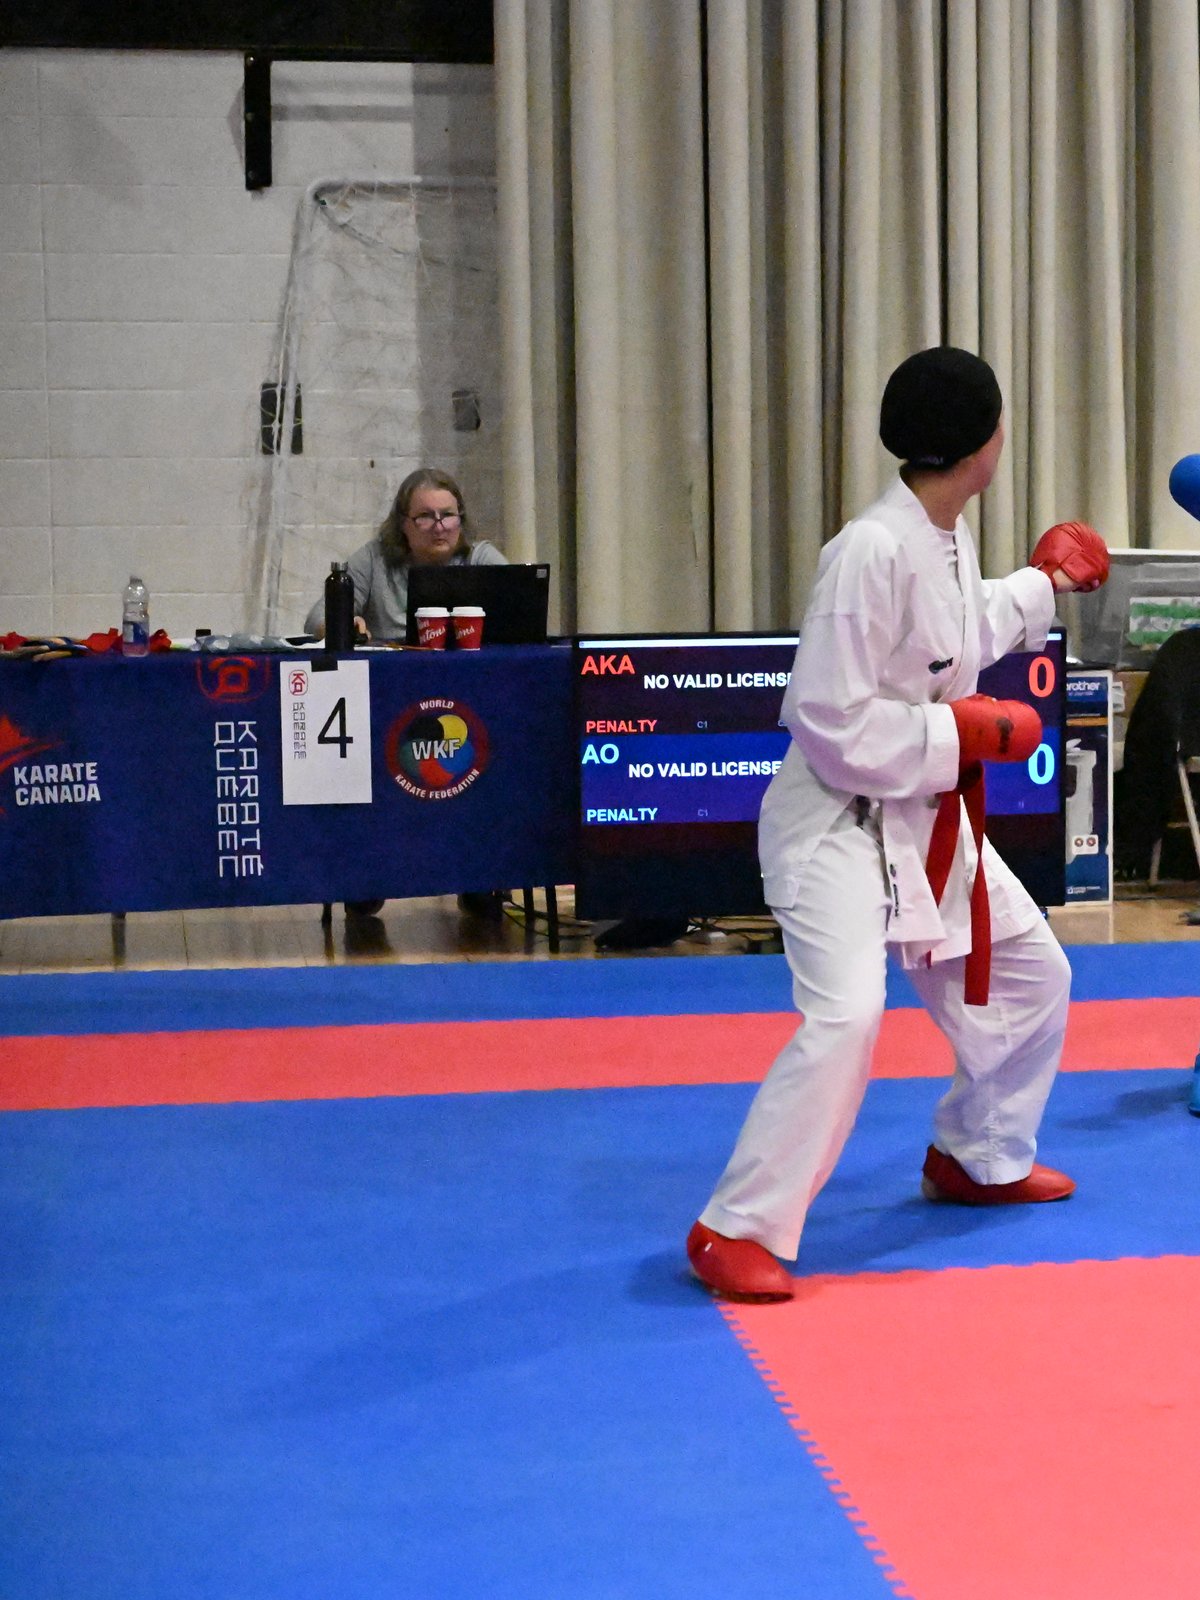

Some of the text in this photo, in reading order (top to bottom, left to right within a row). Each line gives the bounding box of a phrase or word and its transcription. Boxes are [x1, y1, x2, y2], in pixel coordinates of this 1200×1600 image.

[581, 654, 635, 675] AKA
[643, 674, 669, 689] NO
[673, 673, 723, 689] VALID
[1028, 656, 1056, 698] 0
[420, 699, 455, 711] WORLD
[317, 696, 354, 759] 4
[586, 719, 657, 733] PENALTY
[696, 721, 708, 729] C1
[411, 738, 461, 760] WKF
[581, 743, 620, 765] AO
[13, 762, 98, 786] KARATE
[628, 763, 654, 778] NO
[657, 762, 707, 778] VALID
[1028, 743, 1055, 785] 0
[15, 783, 101, 806] CANADA
[395, 768, 480, 799] KARATE FEDERATION
[586, 807, 658, 822] PENALTY
